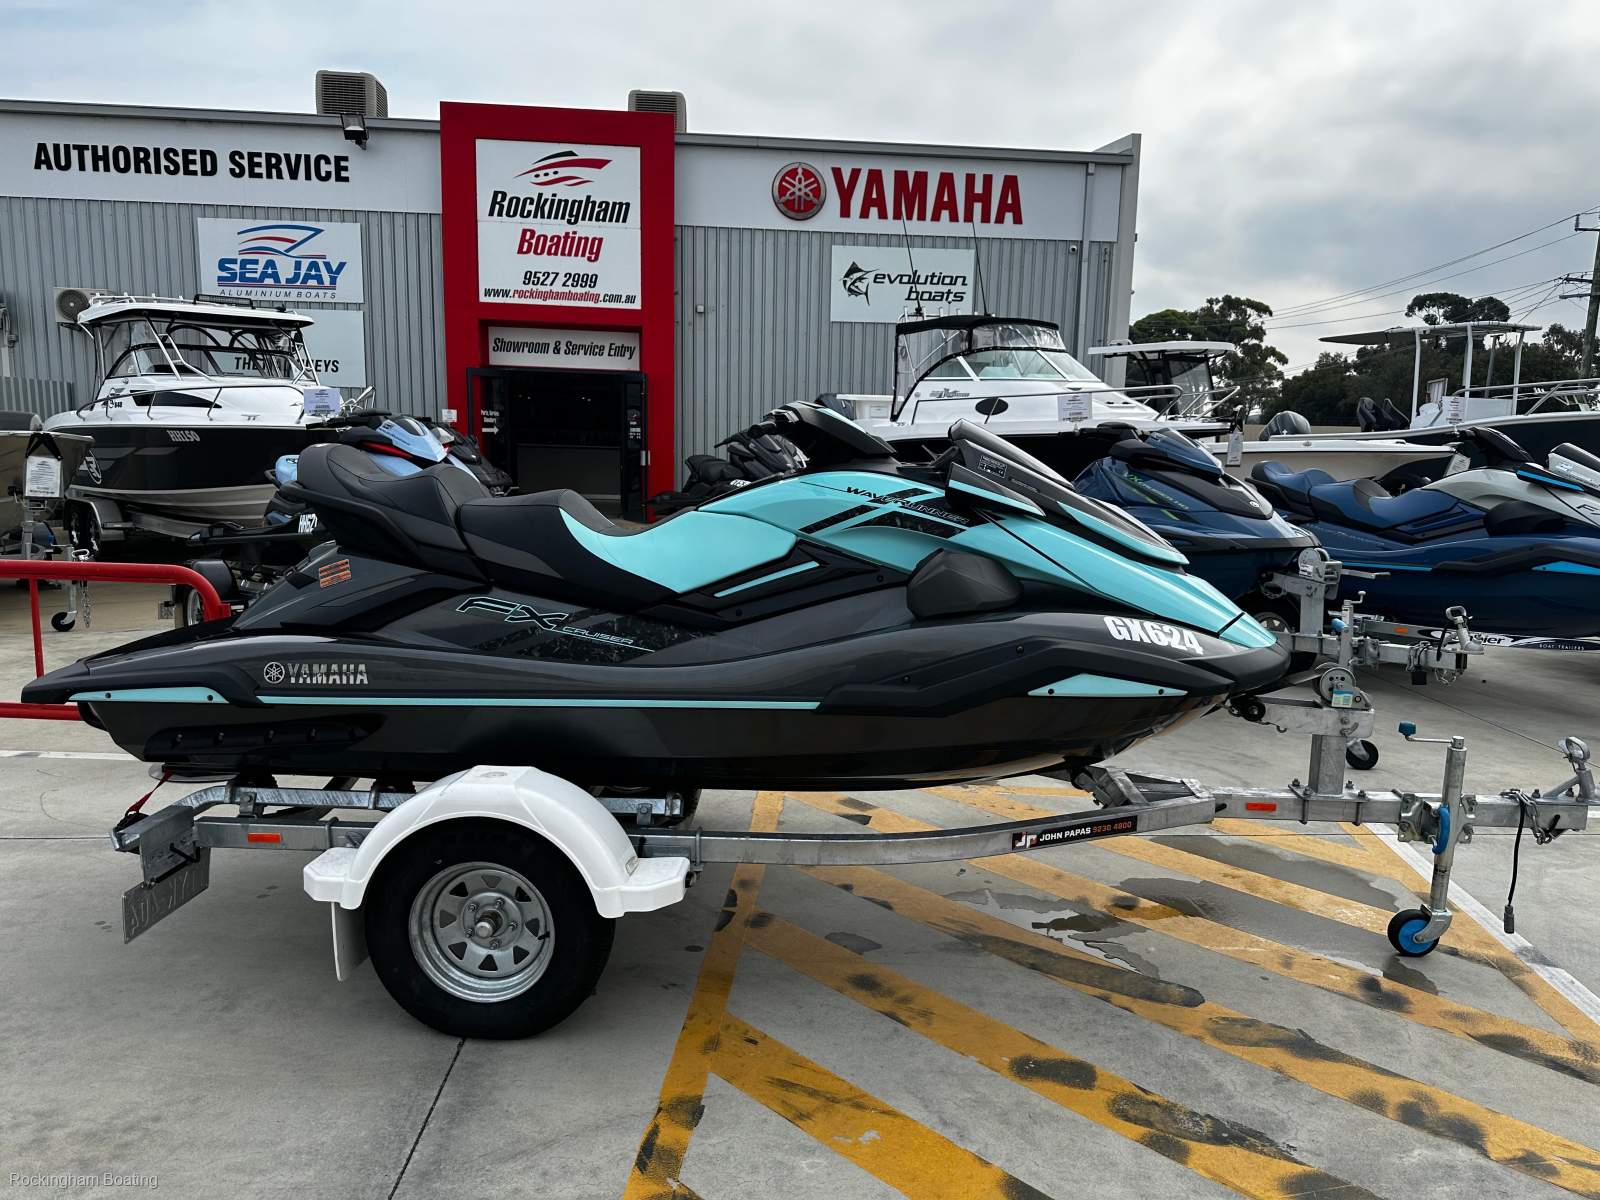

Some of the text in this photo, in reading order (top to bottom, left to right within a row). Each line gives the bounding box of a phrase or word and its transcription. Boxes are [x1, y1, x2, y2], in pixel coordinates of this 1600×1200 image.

[34, 142, 350, 183] AUTHORISED SERVICE
[831, 166, 1023, 225] YAMAHA
[488, 190, 630, 225] Rockingham
[517, 228, 603, 262] Boating
[216, 257, 281, 285] SEA
[522, 270, 598, 288] 9527 2999
[873, 269, 968, 286] evolution
[219, 288, 336, 299] ALUMINIUM BOATS
[484, 286, 636, 304] www.rockinghamboating.com.au
[905, 285, 966, 303] boats
[492, 337, 636, 359] Showroom & Service Entry
[456, 596, 634, 645] FX CRUISER
[1103, 615, 1203, 654] GX624
[287, 663, 368, 685] YAMAHA
[1039, 831, 1063, 842] JOHN
[1064, 827, 1092, 838] PAPAS
[1092, 824, 1111, 833] 9230
